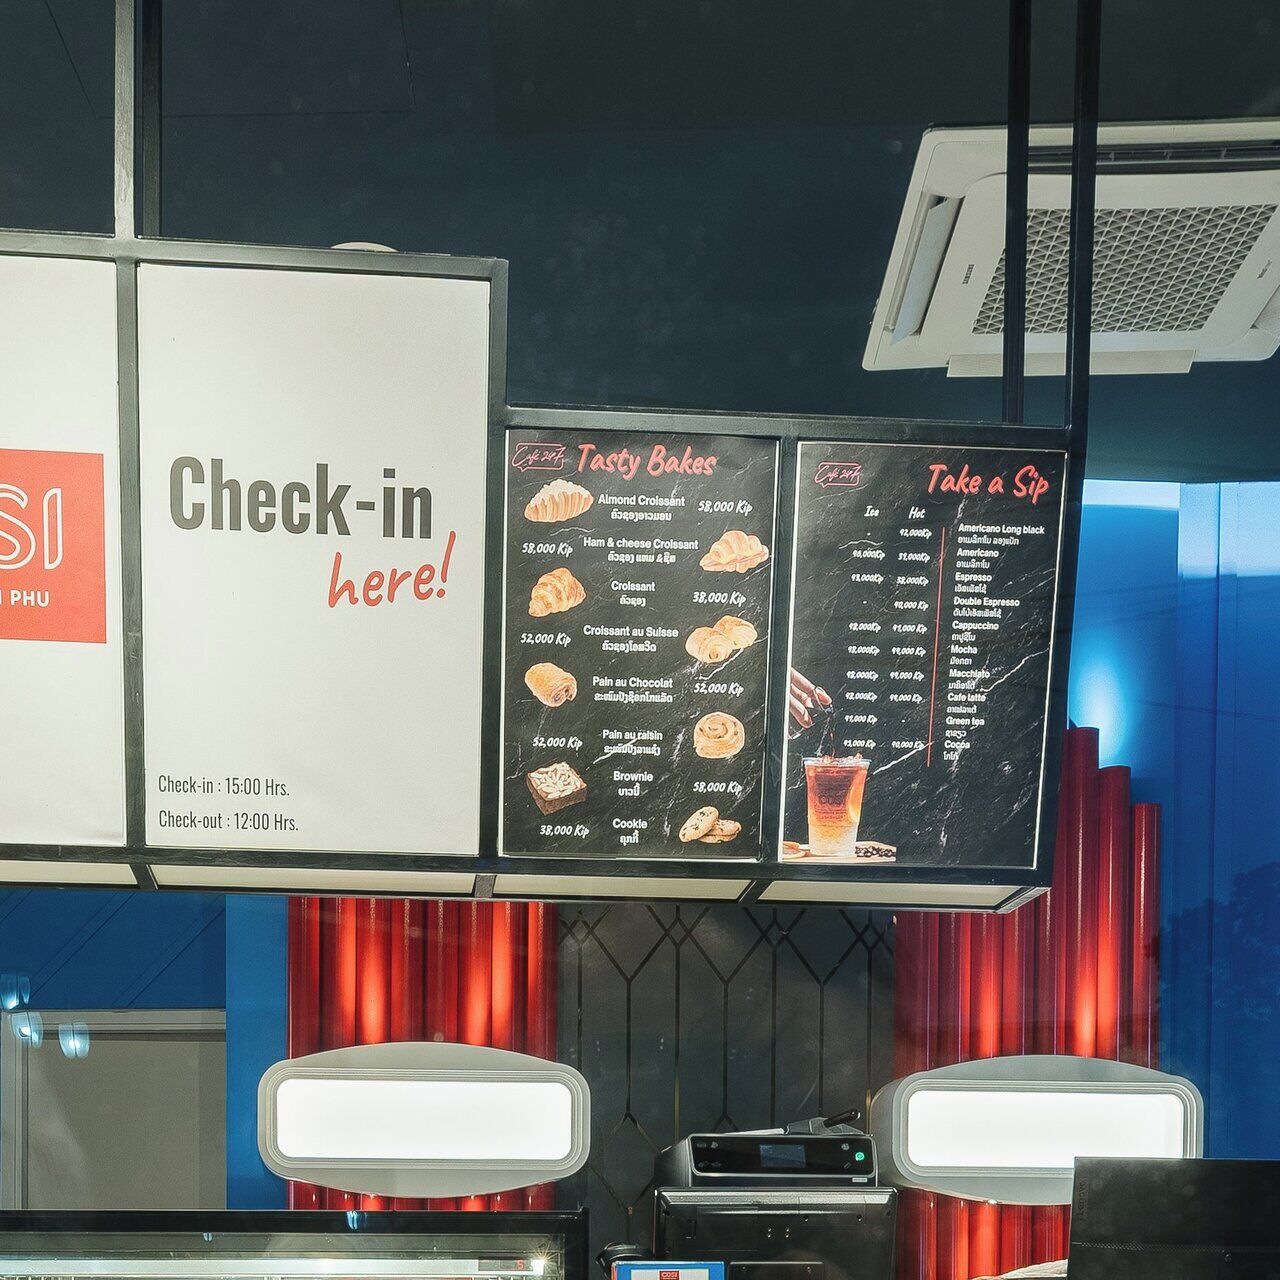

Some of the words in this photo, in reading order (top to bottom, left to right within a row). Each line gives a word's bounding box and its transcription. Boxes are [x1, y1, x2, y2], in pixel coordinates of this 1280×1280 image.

[578, 444, 641, 480] Tasty
[648, 444, 716, 477] Bakes
[928, 464, 982, 494] Take
[988, 474, 1004, 494] a
[1014, 466, 1049, 504] Sip
[170, 456, 432, 539] Check-in
[598, 494, 636, 505] Almond
[638, 493, 685, 509] Croissant
[698, 501, 734, 513] 58,000
[736, 500, 752, 516] Kip
[864, 506, 879, 516] Ice
[909, 507, 925, 519] Hot
[958, 523, 1000, 532] Americano
[1002, 525, 1021, 535] Long
[1023, 525, 1044, 534] black
[522, 543, 555, 554] 58,000
[558, 543, 573, 557] Kip
[584, 537, 605, 547] Ham
[607, 537, 614, 547] &
[616, 538, 651, 548] cheese
[653, 539, 698, 549] Croissant
[957, 548, 999, 557] Americano
[328, 530, 456, 608] here!
[955, 572, 992, 582] Espresso
[611, 581, 655, 591] Croissant
[10, 589, 50, 608] PHU
[693, 592, 728, 604] 38,000
[730, 591, 746, 607] Kip
[954, 596, 982, 605] Double
[983, 598, 1020, 607] Espresso
[584, 625, 630, 636] Croissant
[646, 627, 678, 637] Suisse
[952, 621, 999, 631] Cappuccino
[521, 633, 554, 644] 52,000
[556, 633, 571, 647] Kip
[951, 644, 977, 653] Mocha
[593, 676, 613, 686] Pain
[629, 677, 673, 688] Chocolat
[694, 681, 727, 694] 52,000
[728, 682, 744, 697] Kip
[533, 737, 565, 748] 52,000
[567, 736, 582, 750] Kip
[603, 730, 622, 739] Pain
[624, 732, 637, 742] au
[636, 731, 662, 740] raisin
[945, 740, 970, 751] Cocoa
[614, 771, 653, 781] Brownie
[158, 774, 213, 794] Check-in
[225, 778, 260, 795] 15:00
[266, 779, 290, 796] Hrs.
[693, 782, 726, 793] 58,000
[727, 781, 742, 798] Kip
[159, 810, 222, 829] Check-out
[234, 813, 269, 830] 12:00
[274, 814, 298, 831] Hrs.
[613, 818, 647, 828] Cookie
[540, 825, 572, 836] 38,000
[574, 824, 589, 838] Kip
